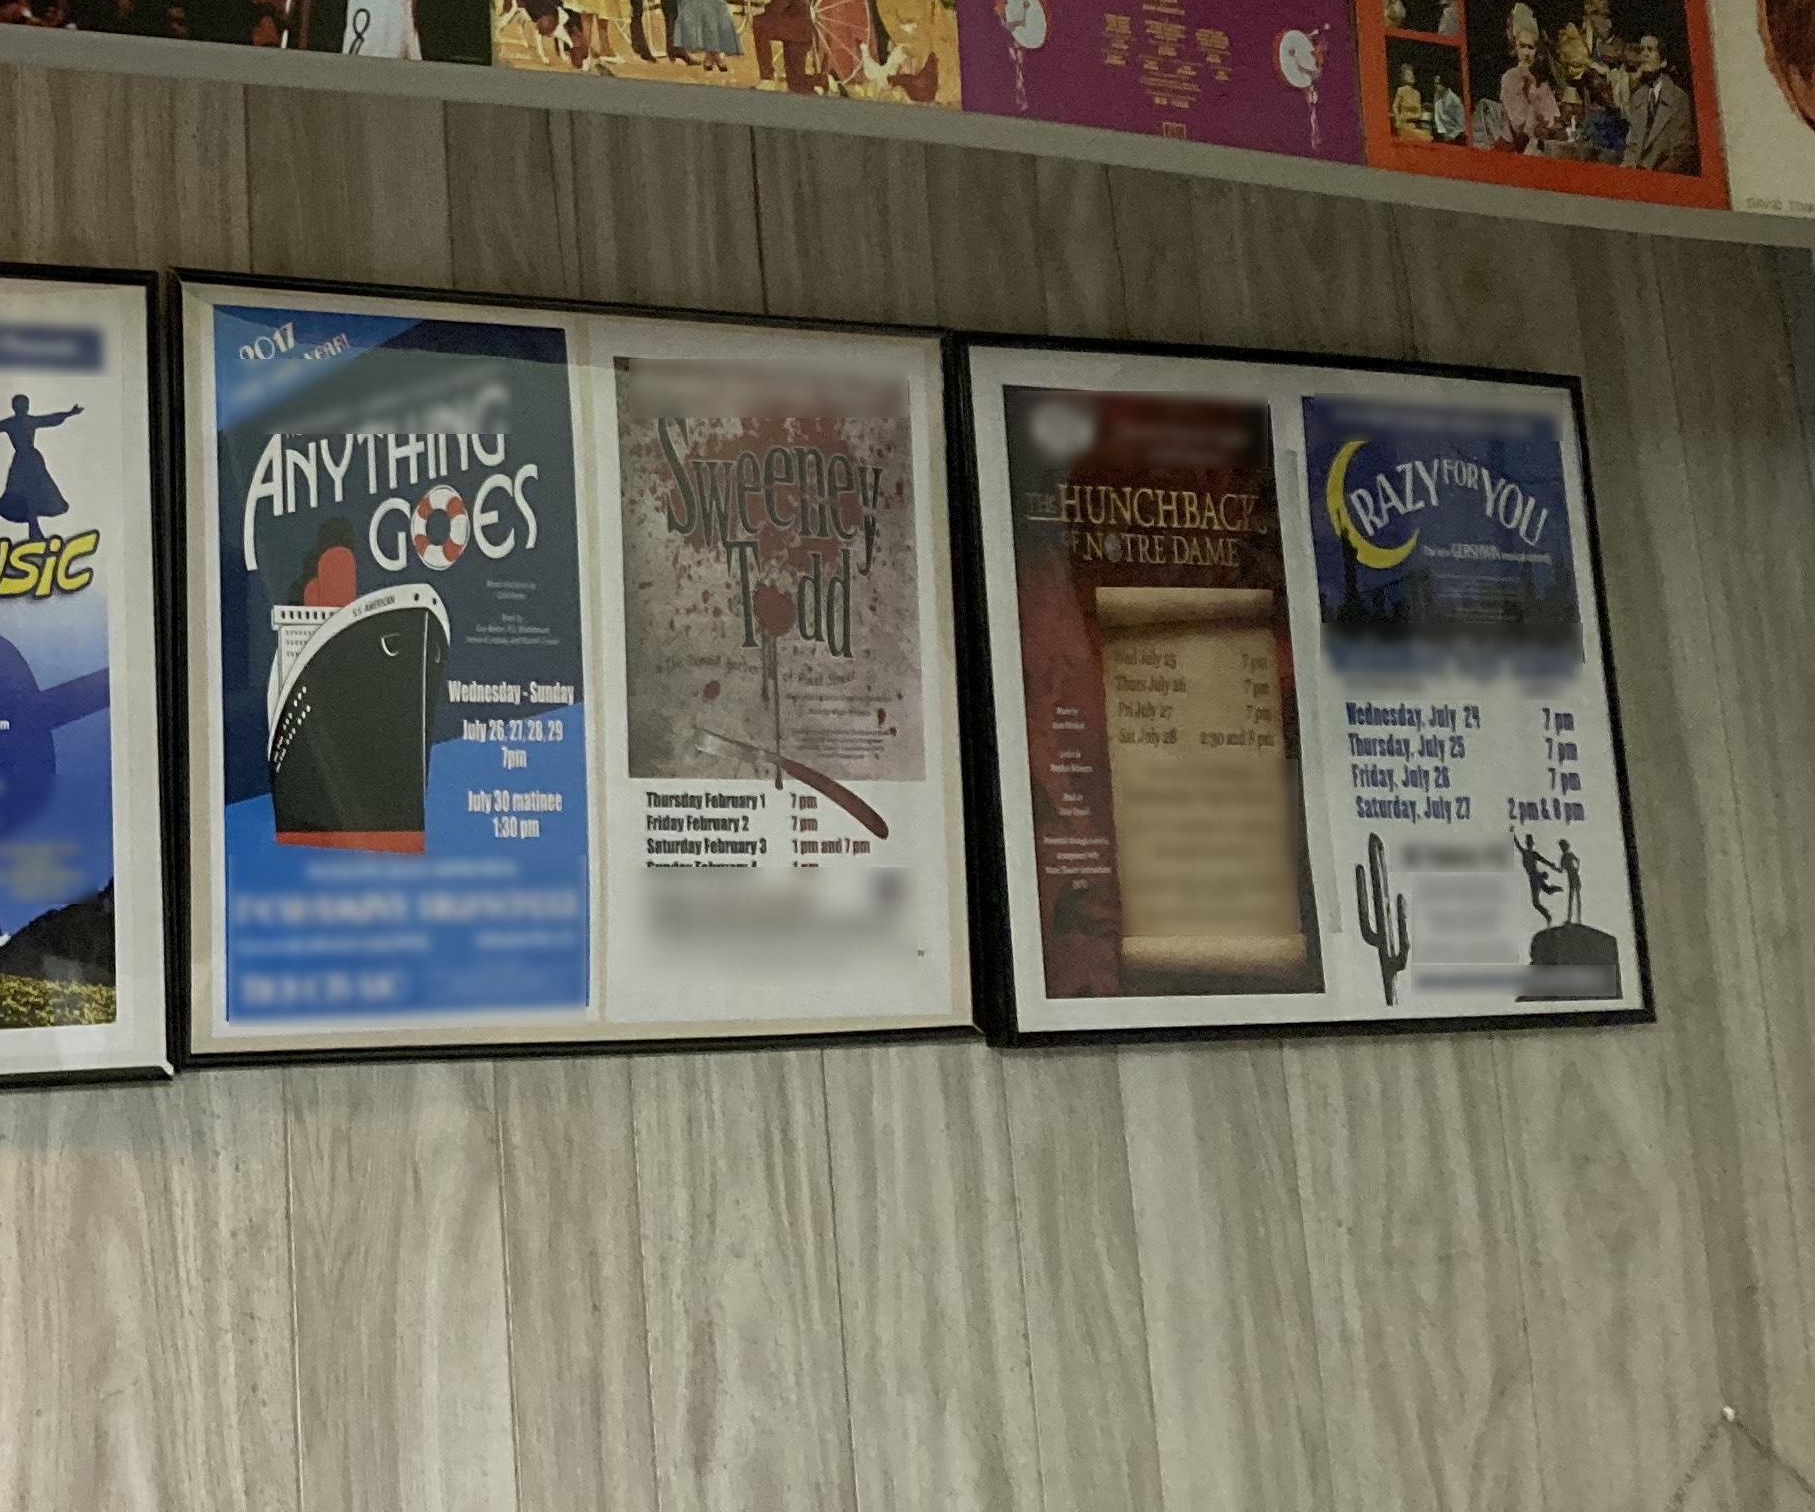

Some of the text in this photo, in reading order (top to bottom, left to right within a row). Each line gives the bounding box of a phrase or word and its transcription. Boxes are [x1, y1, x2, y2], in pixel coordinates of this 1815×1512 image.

[239, 321, 295, 360] 2017
[658, 417, 883, 576] Sweeney
[1057, 483, 1267, 535] HUNCHBACK
[1443, 459, 1479, 490] FOR
[1481, 468, 1549, 546] YOU
[368, 463, 539, 572] GOES
[1173, 536, 1239, 567] DAME
[448, 679, 575, 705] Wednesday Sunday
[463, 719, 487, 742] July
[548, 720, 563, 741] 29
[1429, 705, 1457, 732] July
[1463, 705, 1481, 729] 24
[501, 746, 527, 770] 7pm
[468, 790, 563, 814] July 30 matinee
[646, 791, 703, 810] Thursday
[705, 792, 757, 810] February
[1424, 796, 1453, 824] July
[1456, 797, 1472, 820] 27
[492, 816, 540, 839] 1:30 pm
